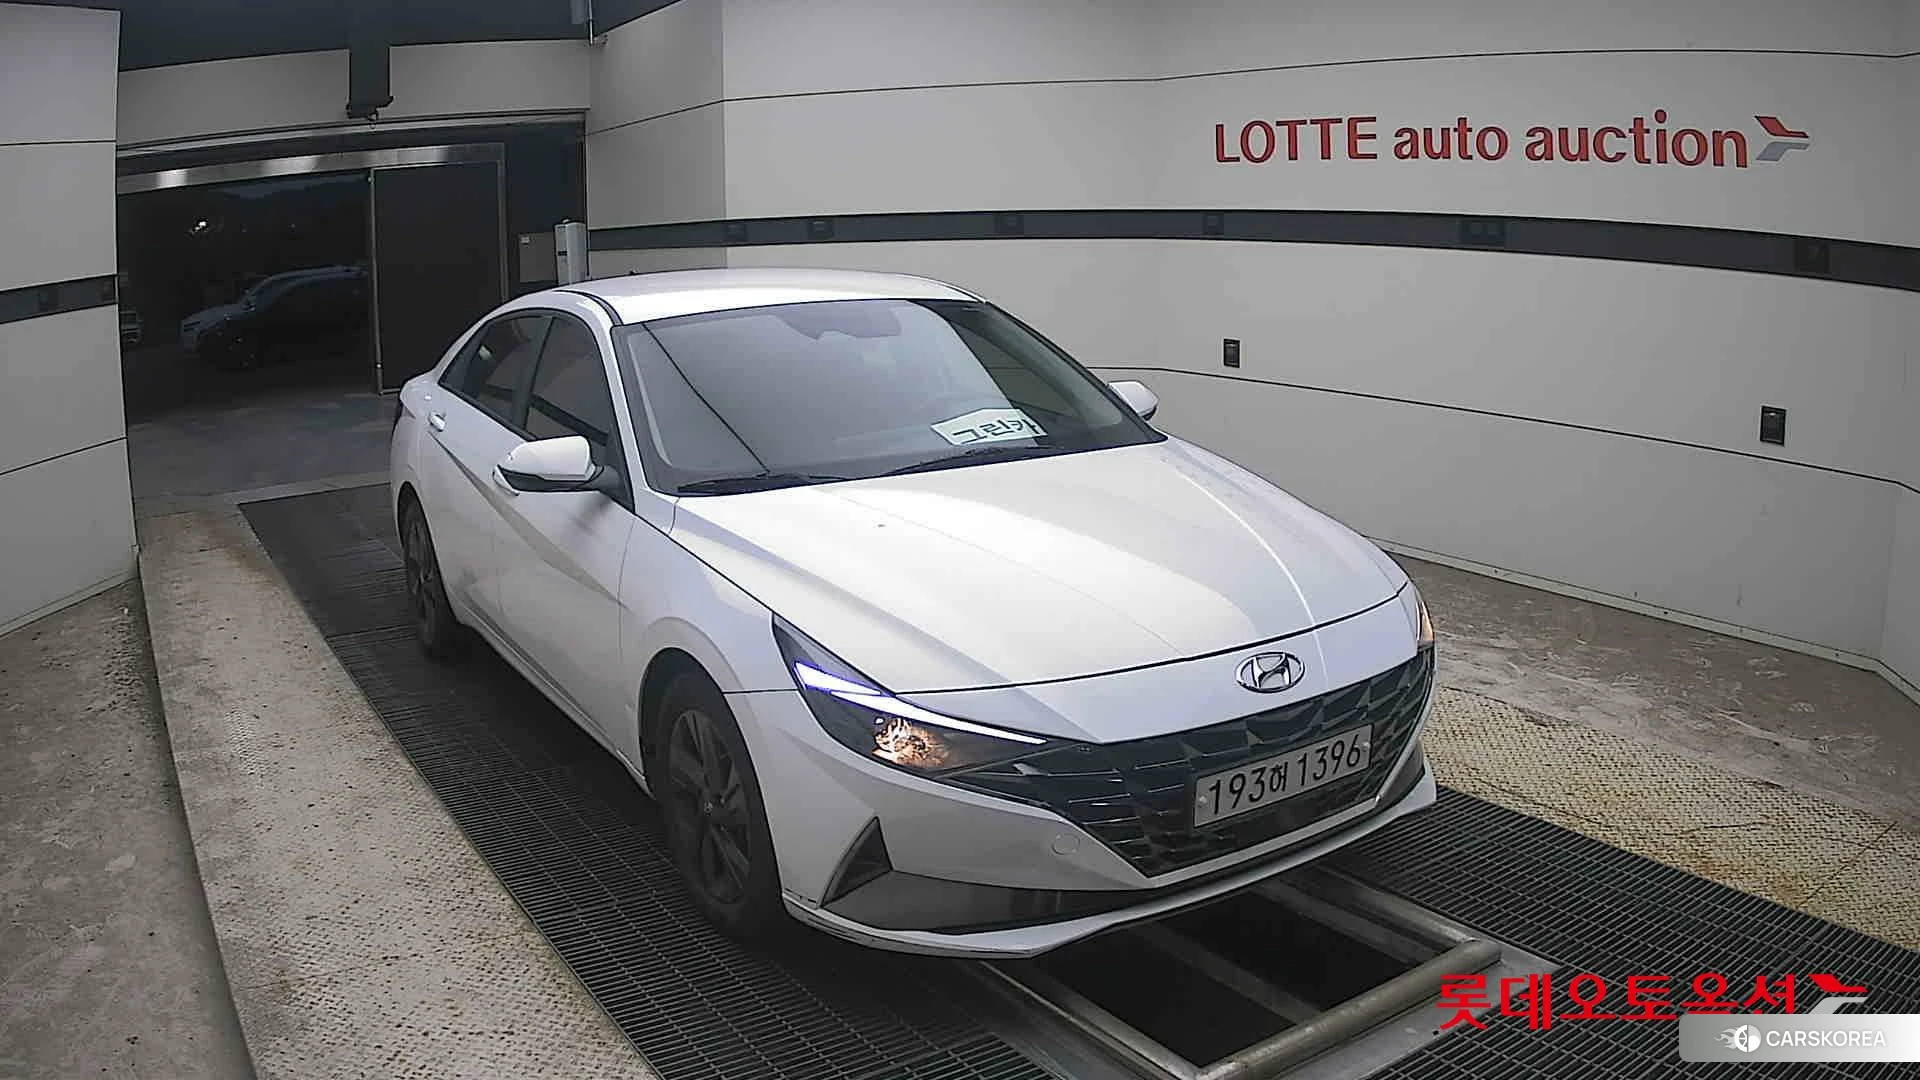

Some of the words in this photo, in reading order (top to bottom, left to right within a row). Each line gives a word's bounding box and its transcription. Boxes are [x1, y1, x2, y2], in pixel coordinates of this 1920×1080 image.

[1215, 116, 1378, 163] LOTTE
[1393, 116, 1509, 161] auto
[1525, 109, 1749, 169] auction
[951, 419, 1041, 444] 그린카
[1208, 761, 1289, 815] 193허
[1298, 734, 1361, 786] 1396
